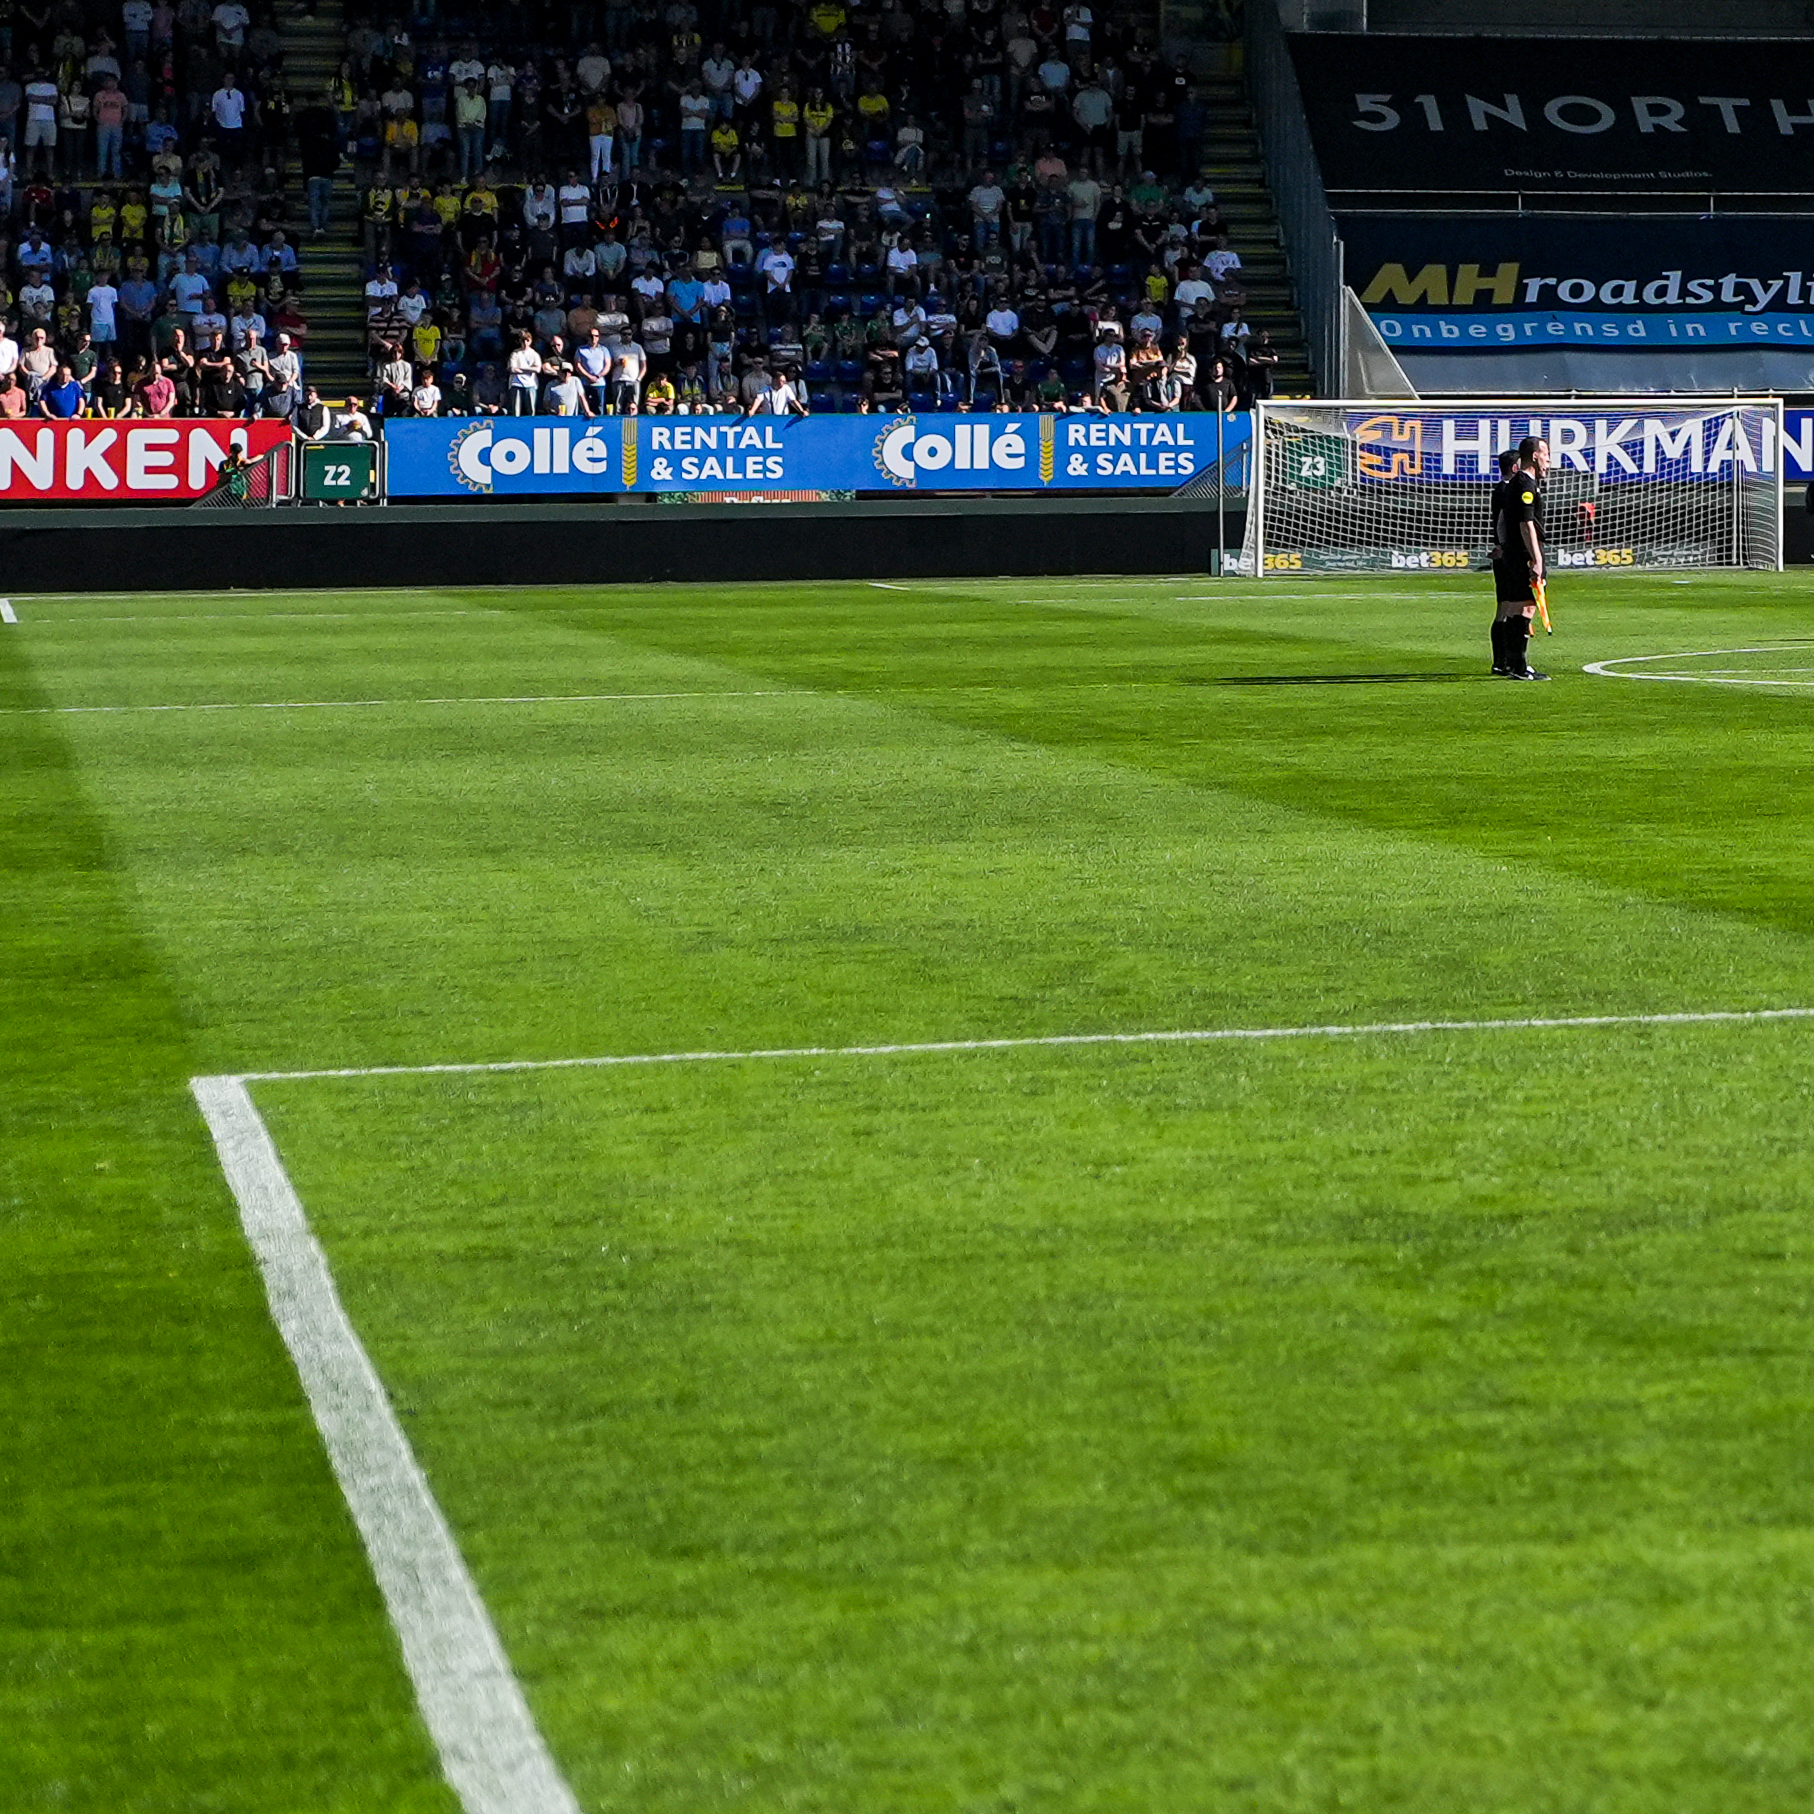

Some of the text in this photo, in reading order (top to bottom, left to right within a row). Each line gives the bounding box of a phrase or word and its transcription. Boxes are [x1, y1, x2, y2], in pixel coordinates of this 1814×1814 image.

[1503, 168, 1550, 182] Design
[1566, 169, 1656, 183] Development
[1658, 170, 1714, 181] Studios.
[1380, 318, 1648, 343] Onbegrensd
[1669, 319, 1706, 339] in
[651, 426, 783, 450] RENTAL
[1067, 423, 1195, 446] RENTAL
[458, 426, 608, 485] Collé
[882, 422, 1025, 480] Collé
[324, 465, 351, 486] Z2
[650, 456, 784, 481] & SALES
[1066, 452, 1195, 476] & SALES
[1301, 456, 1326, 478] Z3
[1391, 549, 1470, 569] bet365
[1557, 547, 1634, 567] bet365
